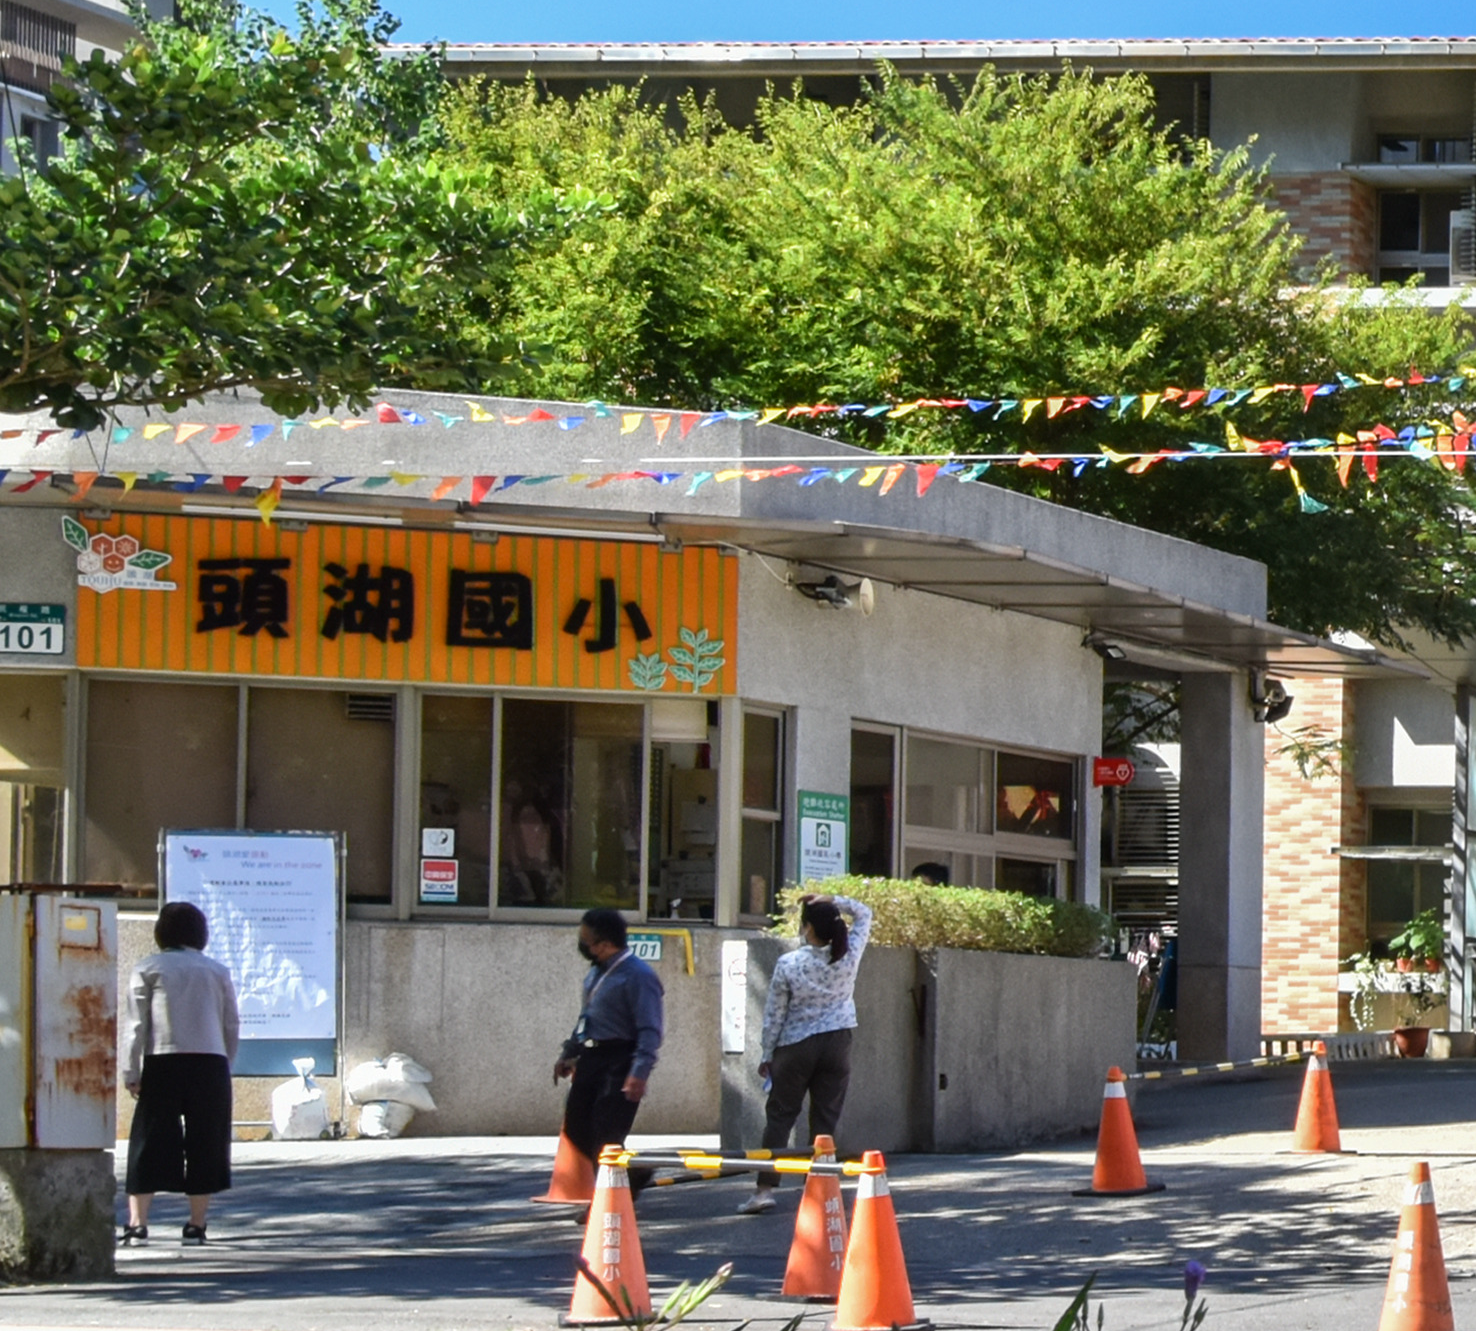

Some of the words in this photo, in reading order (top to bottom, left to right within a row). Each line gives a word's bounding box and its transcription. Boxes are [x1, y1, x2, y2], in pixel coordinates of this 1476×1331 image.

[196, 557, 652, 653] 頭湖國小
[0, 625, 52, 649] 101
[632, 943, 657, 957] 101
